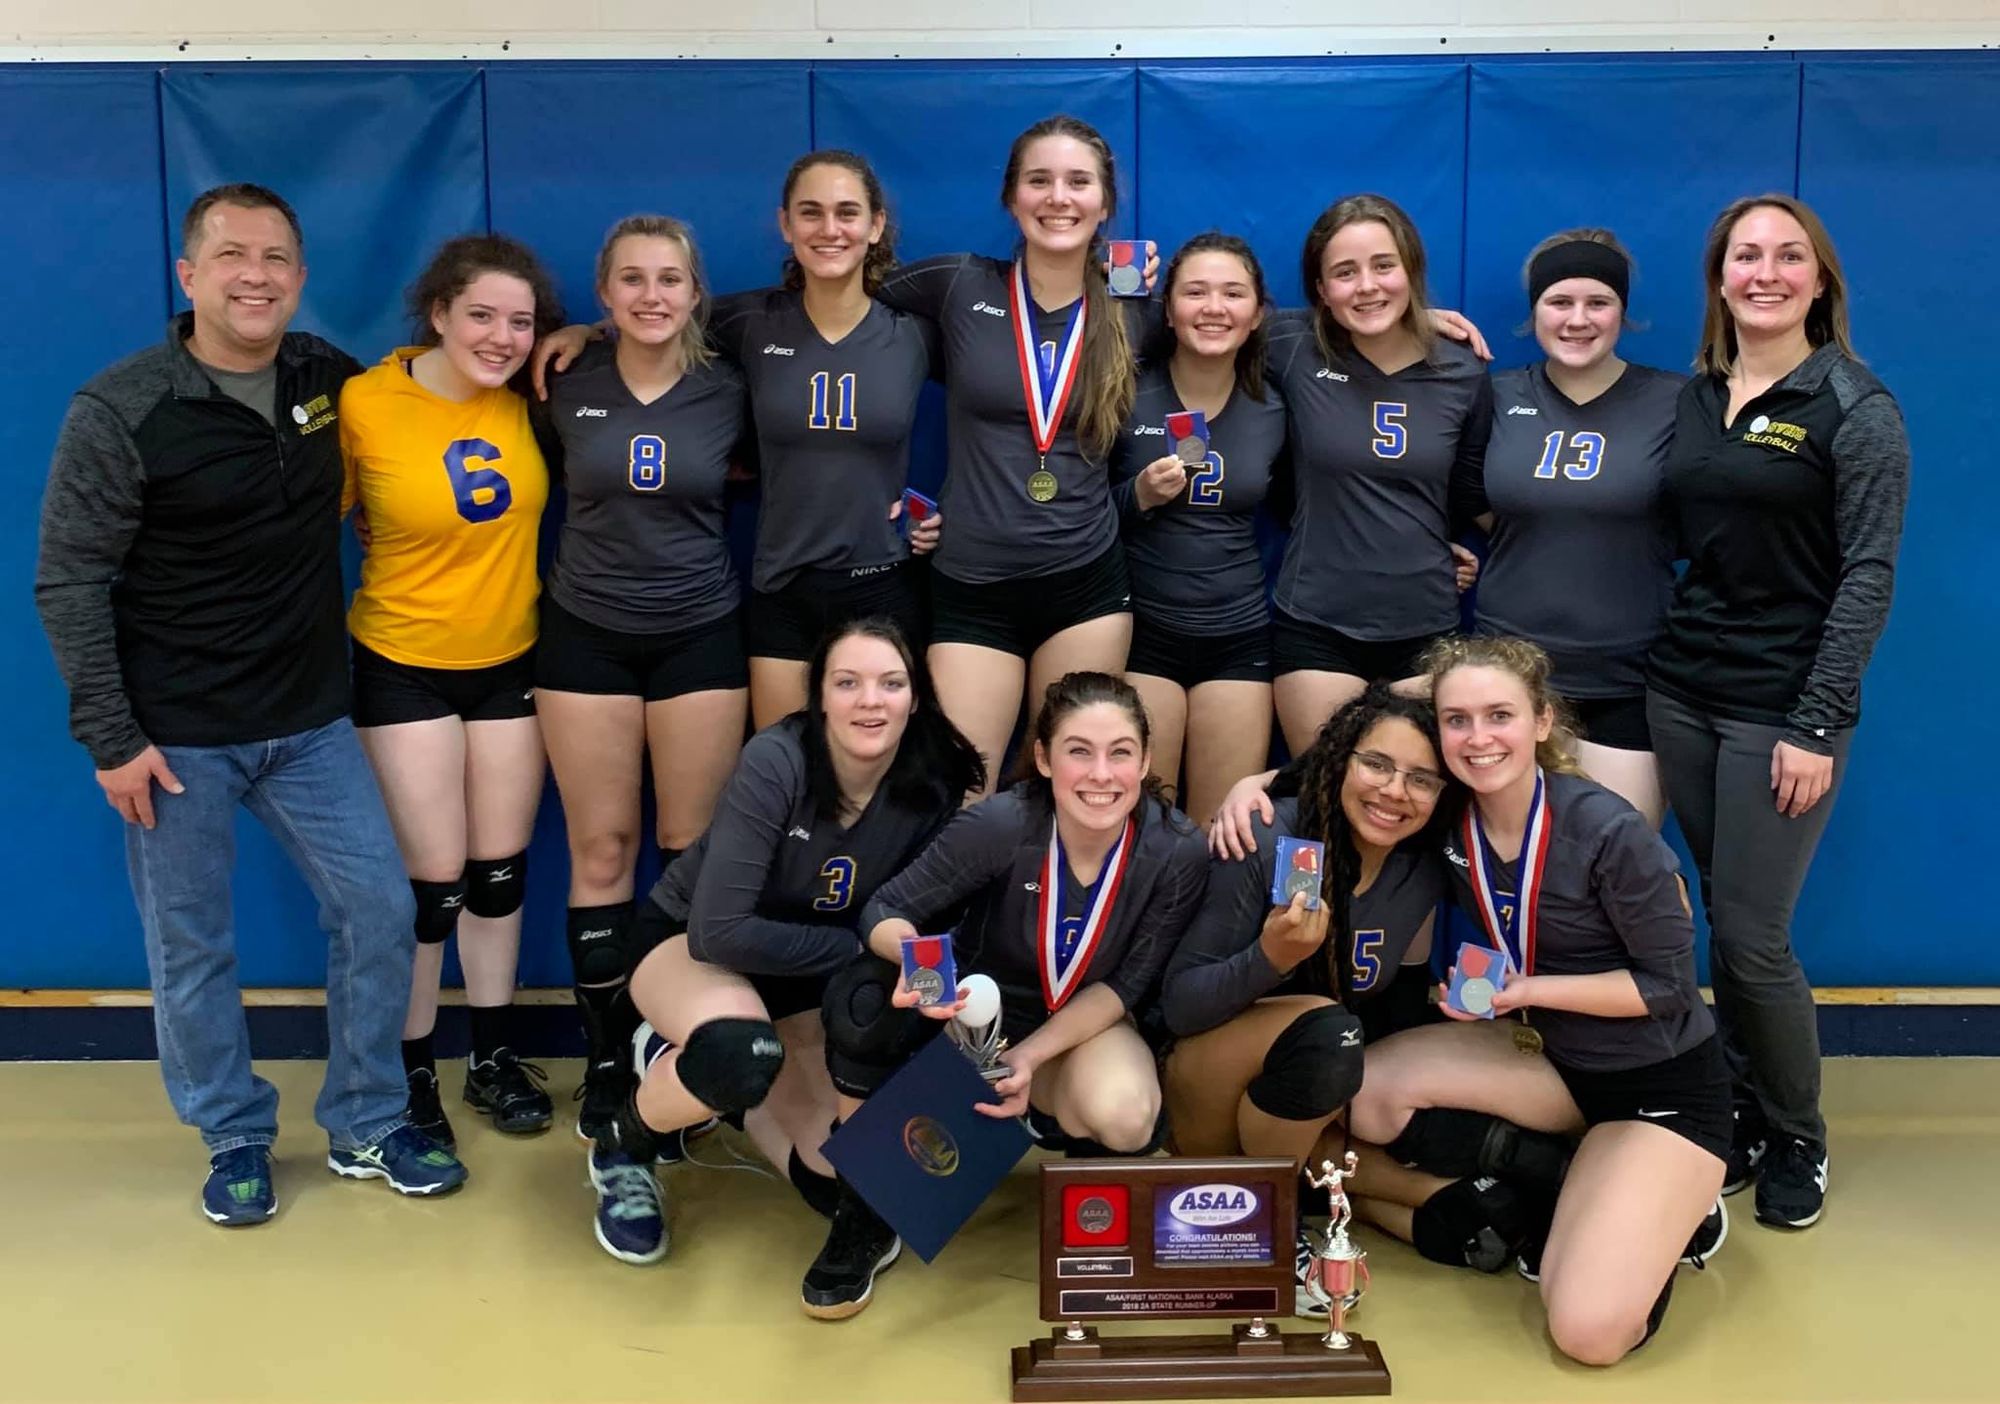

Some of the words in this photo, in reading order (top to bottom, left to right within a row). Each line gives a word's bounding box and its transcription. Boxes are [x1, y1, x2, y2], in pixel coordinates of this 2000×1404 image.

[808, 371, 857, 431] 11
[1372, 401, 1407, 459] 5
[1534, 430, 1606, 480] 13
[443, 438, 513, 524] 6
[628, 434, 666, 491] 8
[1188, 450, 1224, 506] 2
[813, 856, 857, 911] 3
[1179, 1191, 1247, 1210] ASAA
[1169, 1233, 1257, 1242] CONGRATULATIONS!
[1206, 1292, 1233, 1300] ALASKA
